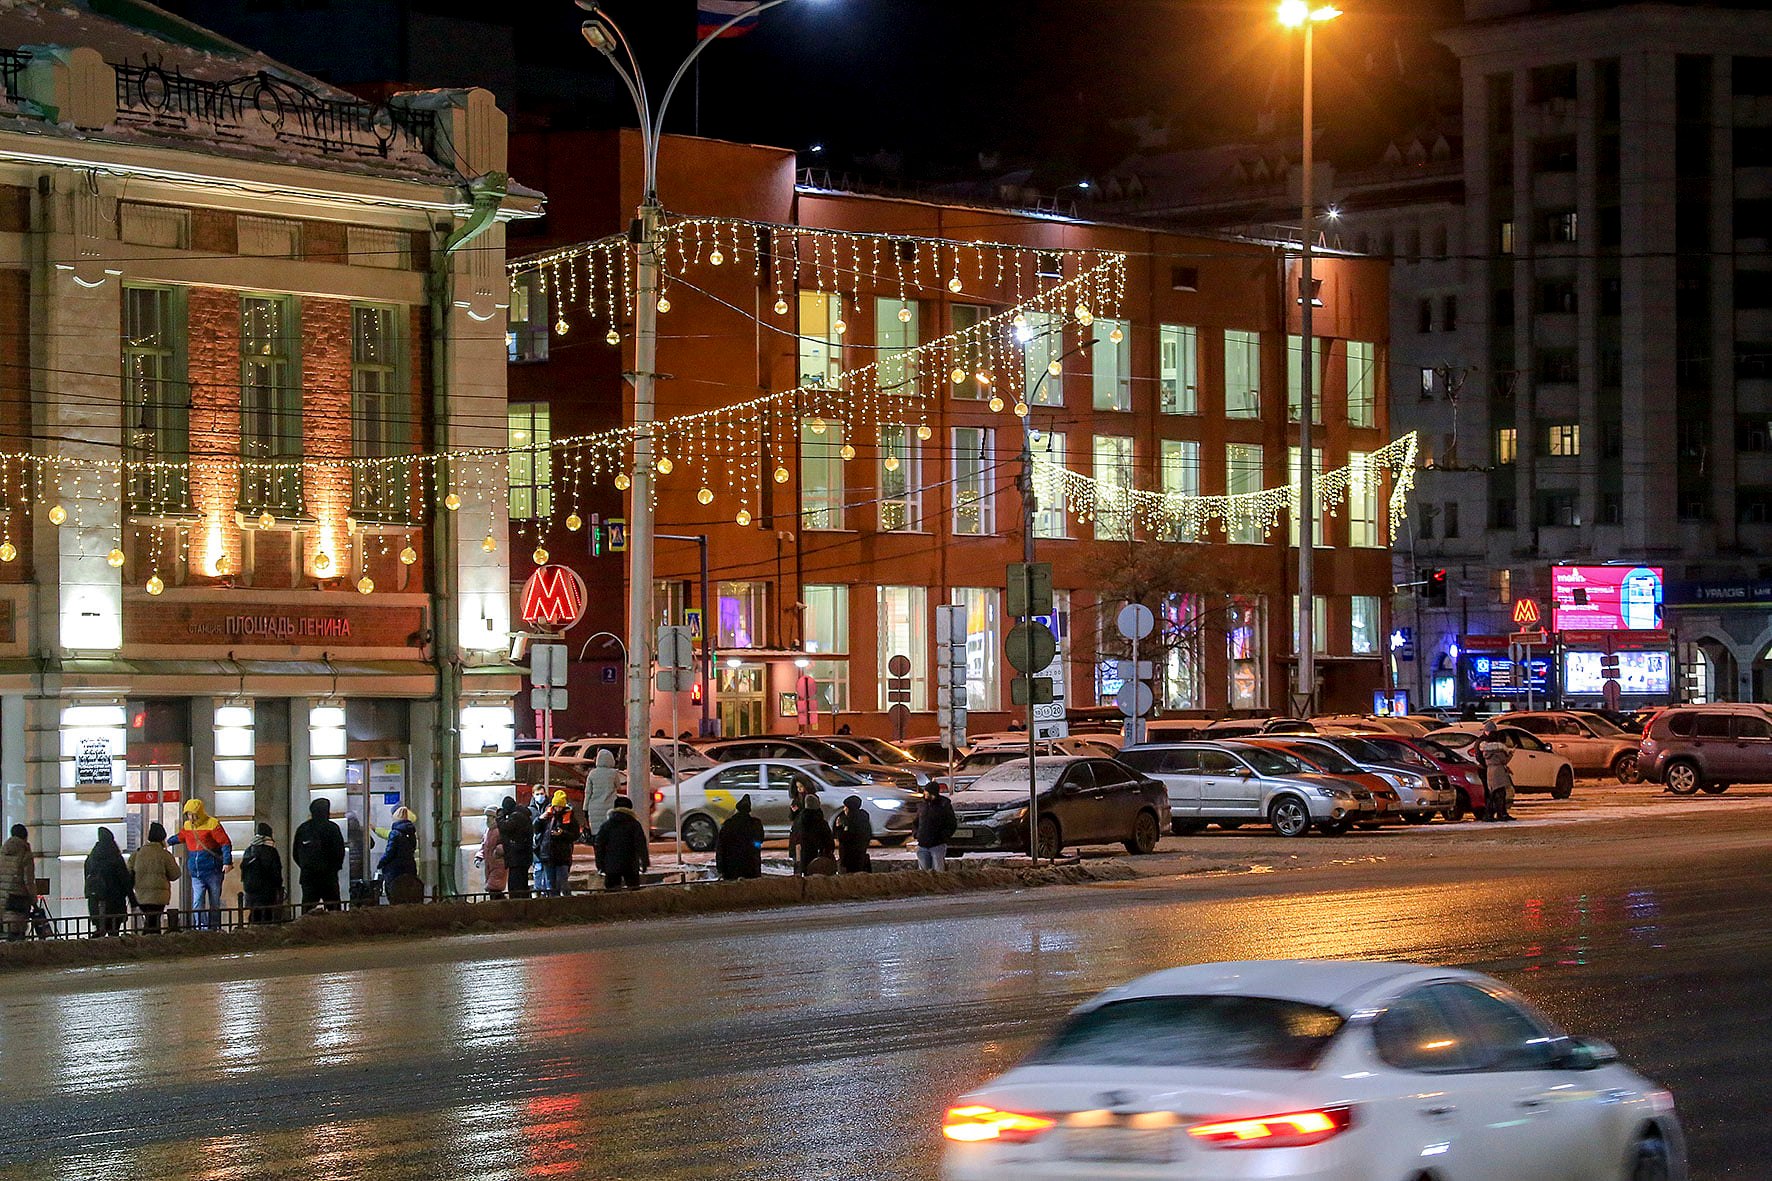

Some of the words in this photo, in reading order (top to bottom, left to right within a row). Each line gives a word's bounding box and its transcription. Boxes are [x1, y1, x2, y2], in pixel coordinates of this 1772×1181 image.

[225, 616, 295, 638] ПЛОЩАДЬ
[298, 618, 352, 637] ЛЕНИНА
[606, 668, 613, 679] 2
